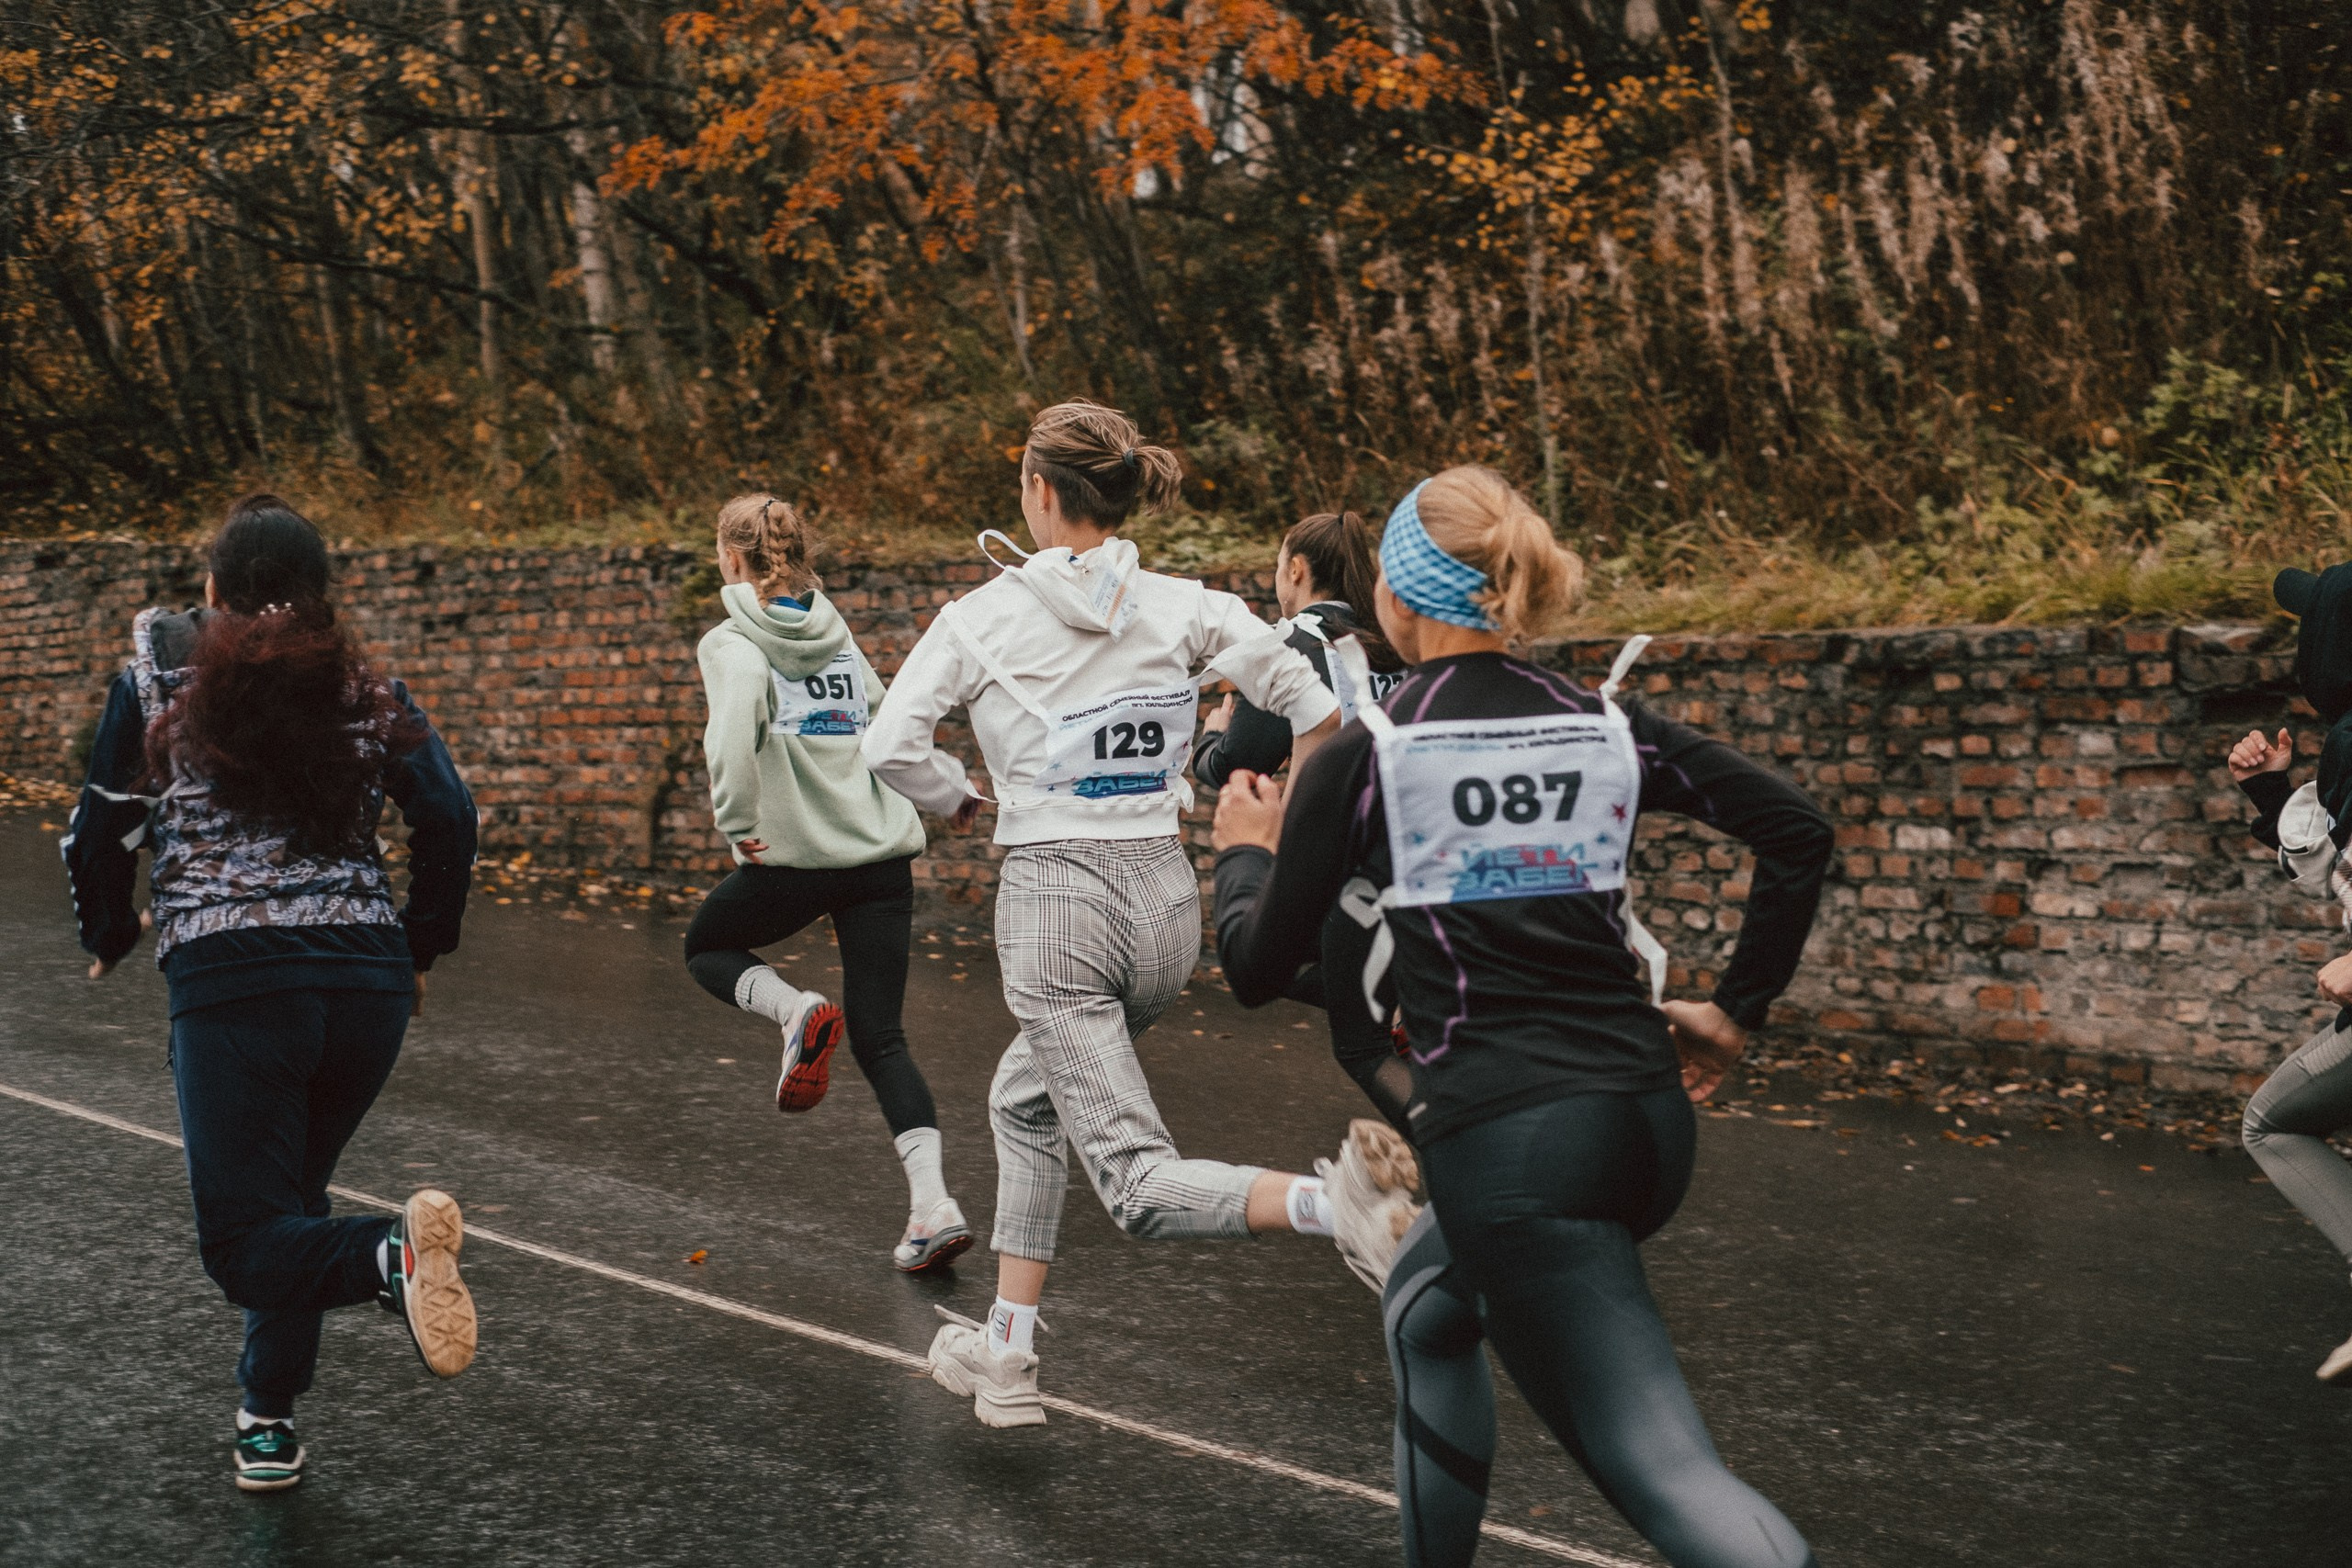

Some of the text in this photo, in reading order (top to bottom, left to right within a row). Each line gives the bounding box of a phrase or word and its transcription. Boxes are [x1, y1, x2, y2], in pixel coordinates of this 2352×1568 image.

[804, 673, 854, 700] 051
[1062, 704, 1109, 722] ОБЛАСТНОЙ
[1150, 689, 1191, 701] ФЕСТИВАЛ
[1091, 720, 1165, 761] 129
[1452, 771, 1583, 827] 087
